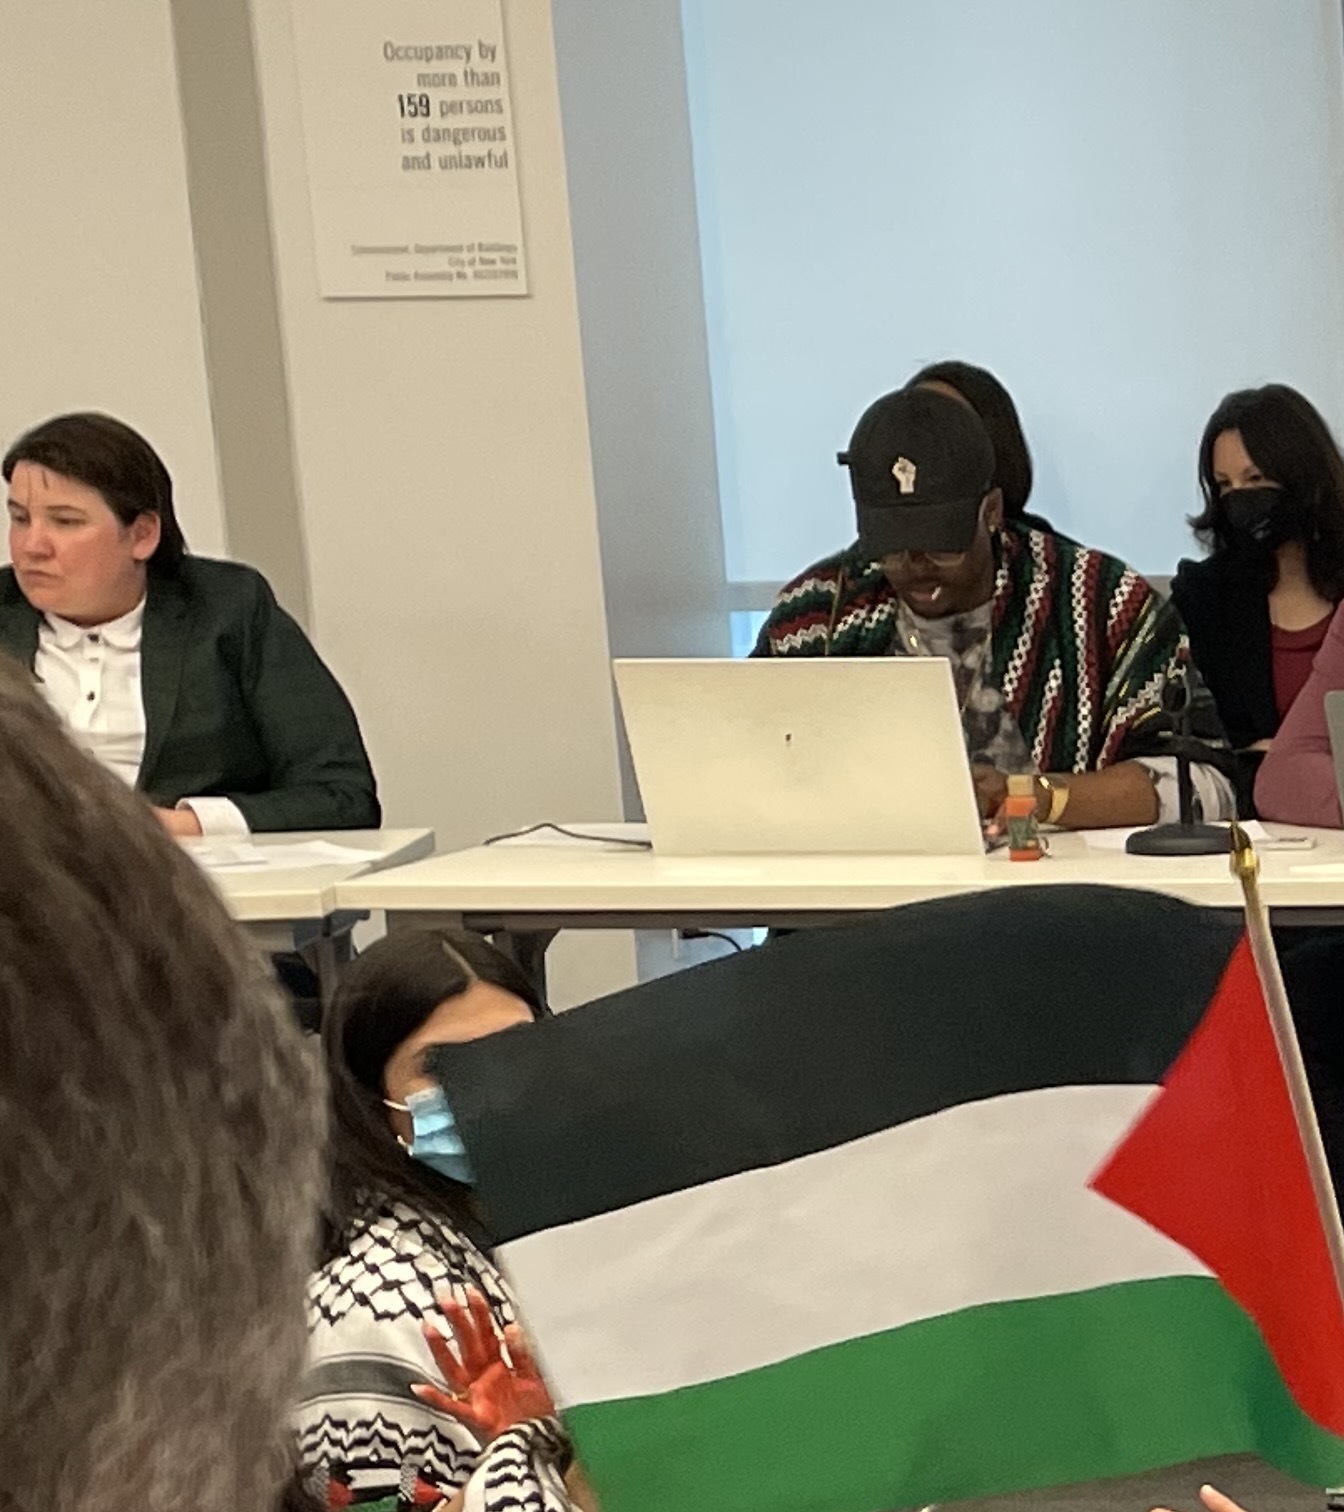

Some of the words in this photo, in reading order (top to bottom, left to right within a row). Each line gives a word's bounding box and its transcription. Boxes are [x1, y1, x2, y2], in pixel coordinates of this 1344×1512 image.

[383, 40, 473, 64] Occupancy
[477, 38, 497, 64] by
[416, 71, 457, 88] more
[463, 66, 501, 88] than
[397, 92, 431, 118] 159
[439, 97, 504, 120] persons
[401, 126, 415, 144] is
[421, 123, 507, 146] dangerous
[401, 151, 431, 171] and
[438, 148, 509, 171] unlawful
